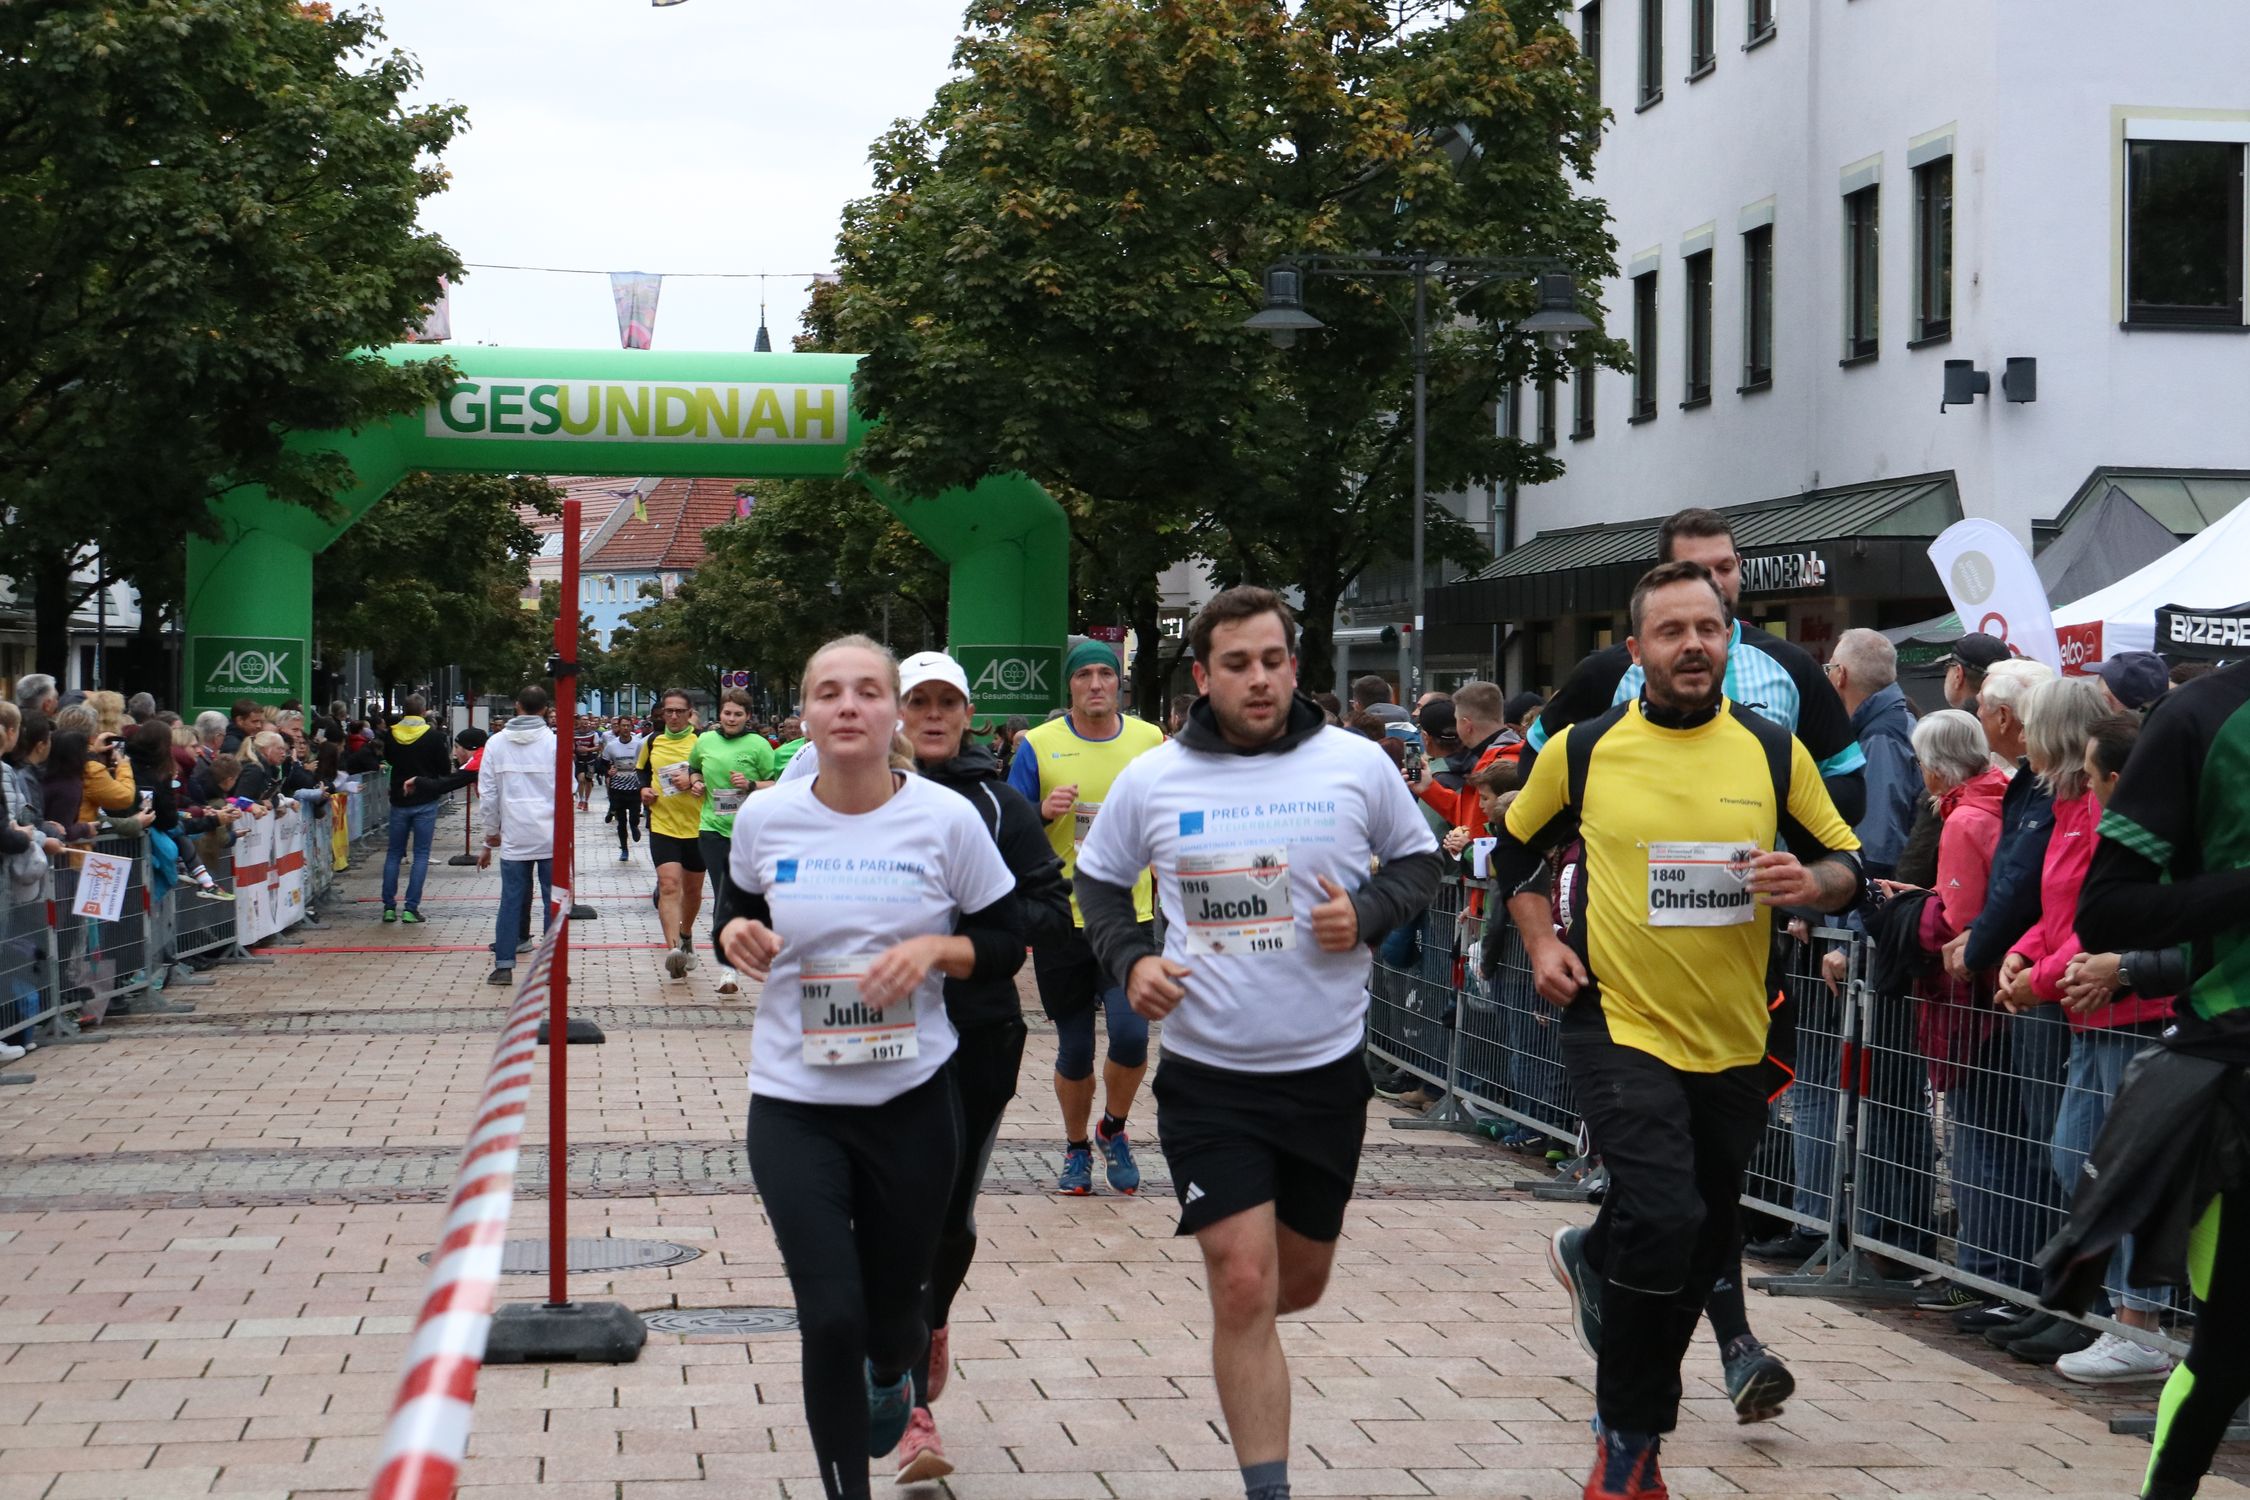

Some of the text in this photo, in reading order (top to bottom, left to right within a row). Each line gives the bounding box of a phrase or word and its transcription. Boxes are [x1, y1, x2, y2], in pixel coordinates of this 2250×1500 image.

[440, 382, 835, 440] GESUNDNAH
[207, 650, 289, 684] AOK
[972, 658, 1048, 691] AOK
[205, 685, 216, 693] Die
[1212, 801, 1335, 820] PREG & PARTNER
[805, 858, 926, 874] PREG & PARTNER
[1651, 868, 1685, 881] 1840
[1181, 880, 1209, 893] 1916
[1199, 894, 1268, 920] Jacob
[1250, 937, 1283, 952] 1916
[802, 984, 831, 998] 1917
[823, 1002, 883, 1026] Julia
[872, 1044, 904, 1059] 1917
